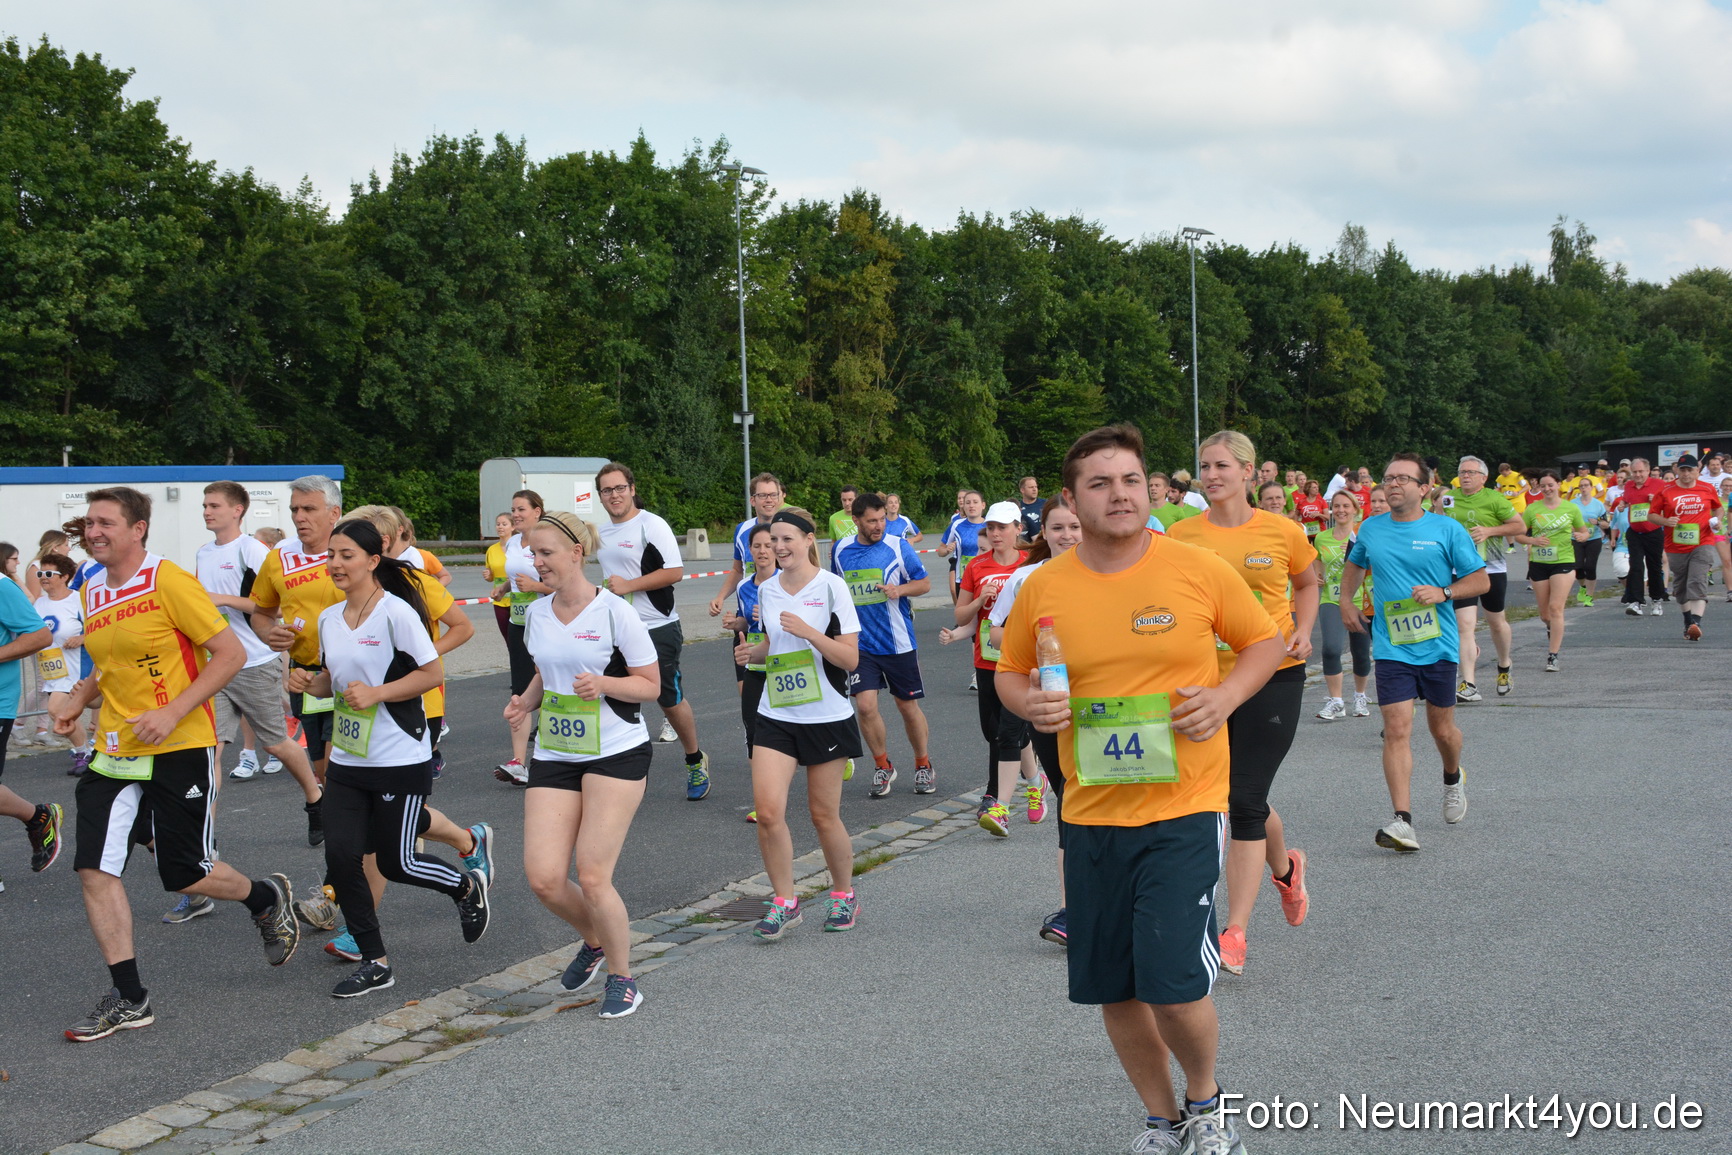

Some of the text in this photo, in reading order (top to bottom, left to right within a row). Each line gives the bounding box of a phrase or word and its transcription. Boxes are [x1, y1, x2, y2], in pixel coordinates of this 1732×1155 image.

[1673, 494, 1696, 505] Town
[1674, 502, 1705, 516] Country
[1677, 532, 1695, 540] 425
[1536, 548, 1553, 556] 195
[285, 571, 320, 590] MAX
[850, 583, 881, 596] 1144
[86, 598, 161, 636] MAX BÖGL
[1135, 615, 1160, 629] plank
[1392, 611, 1434, 632] 1104
[40, 659, 63, 672] 1590
[775, 672, 808, 693] 386
[337, 715, 361, 740] 388
[548, 716, 586, 738] 389
[1103, 732, 1145, 761] 44
